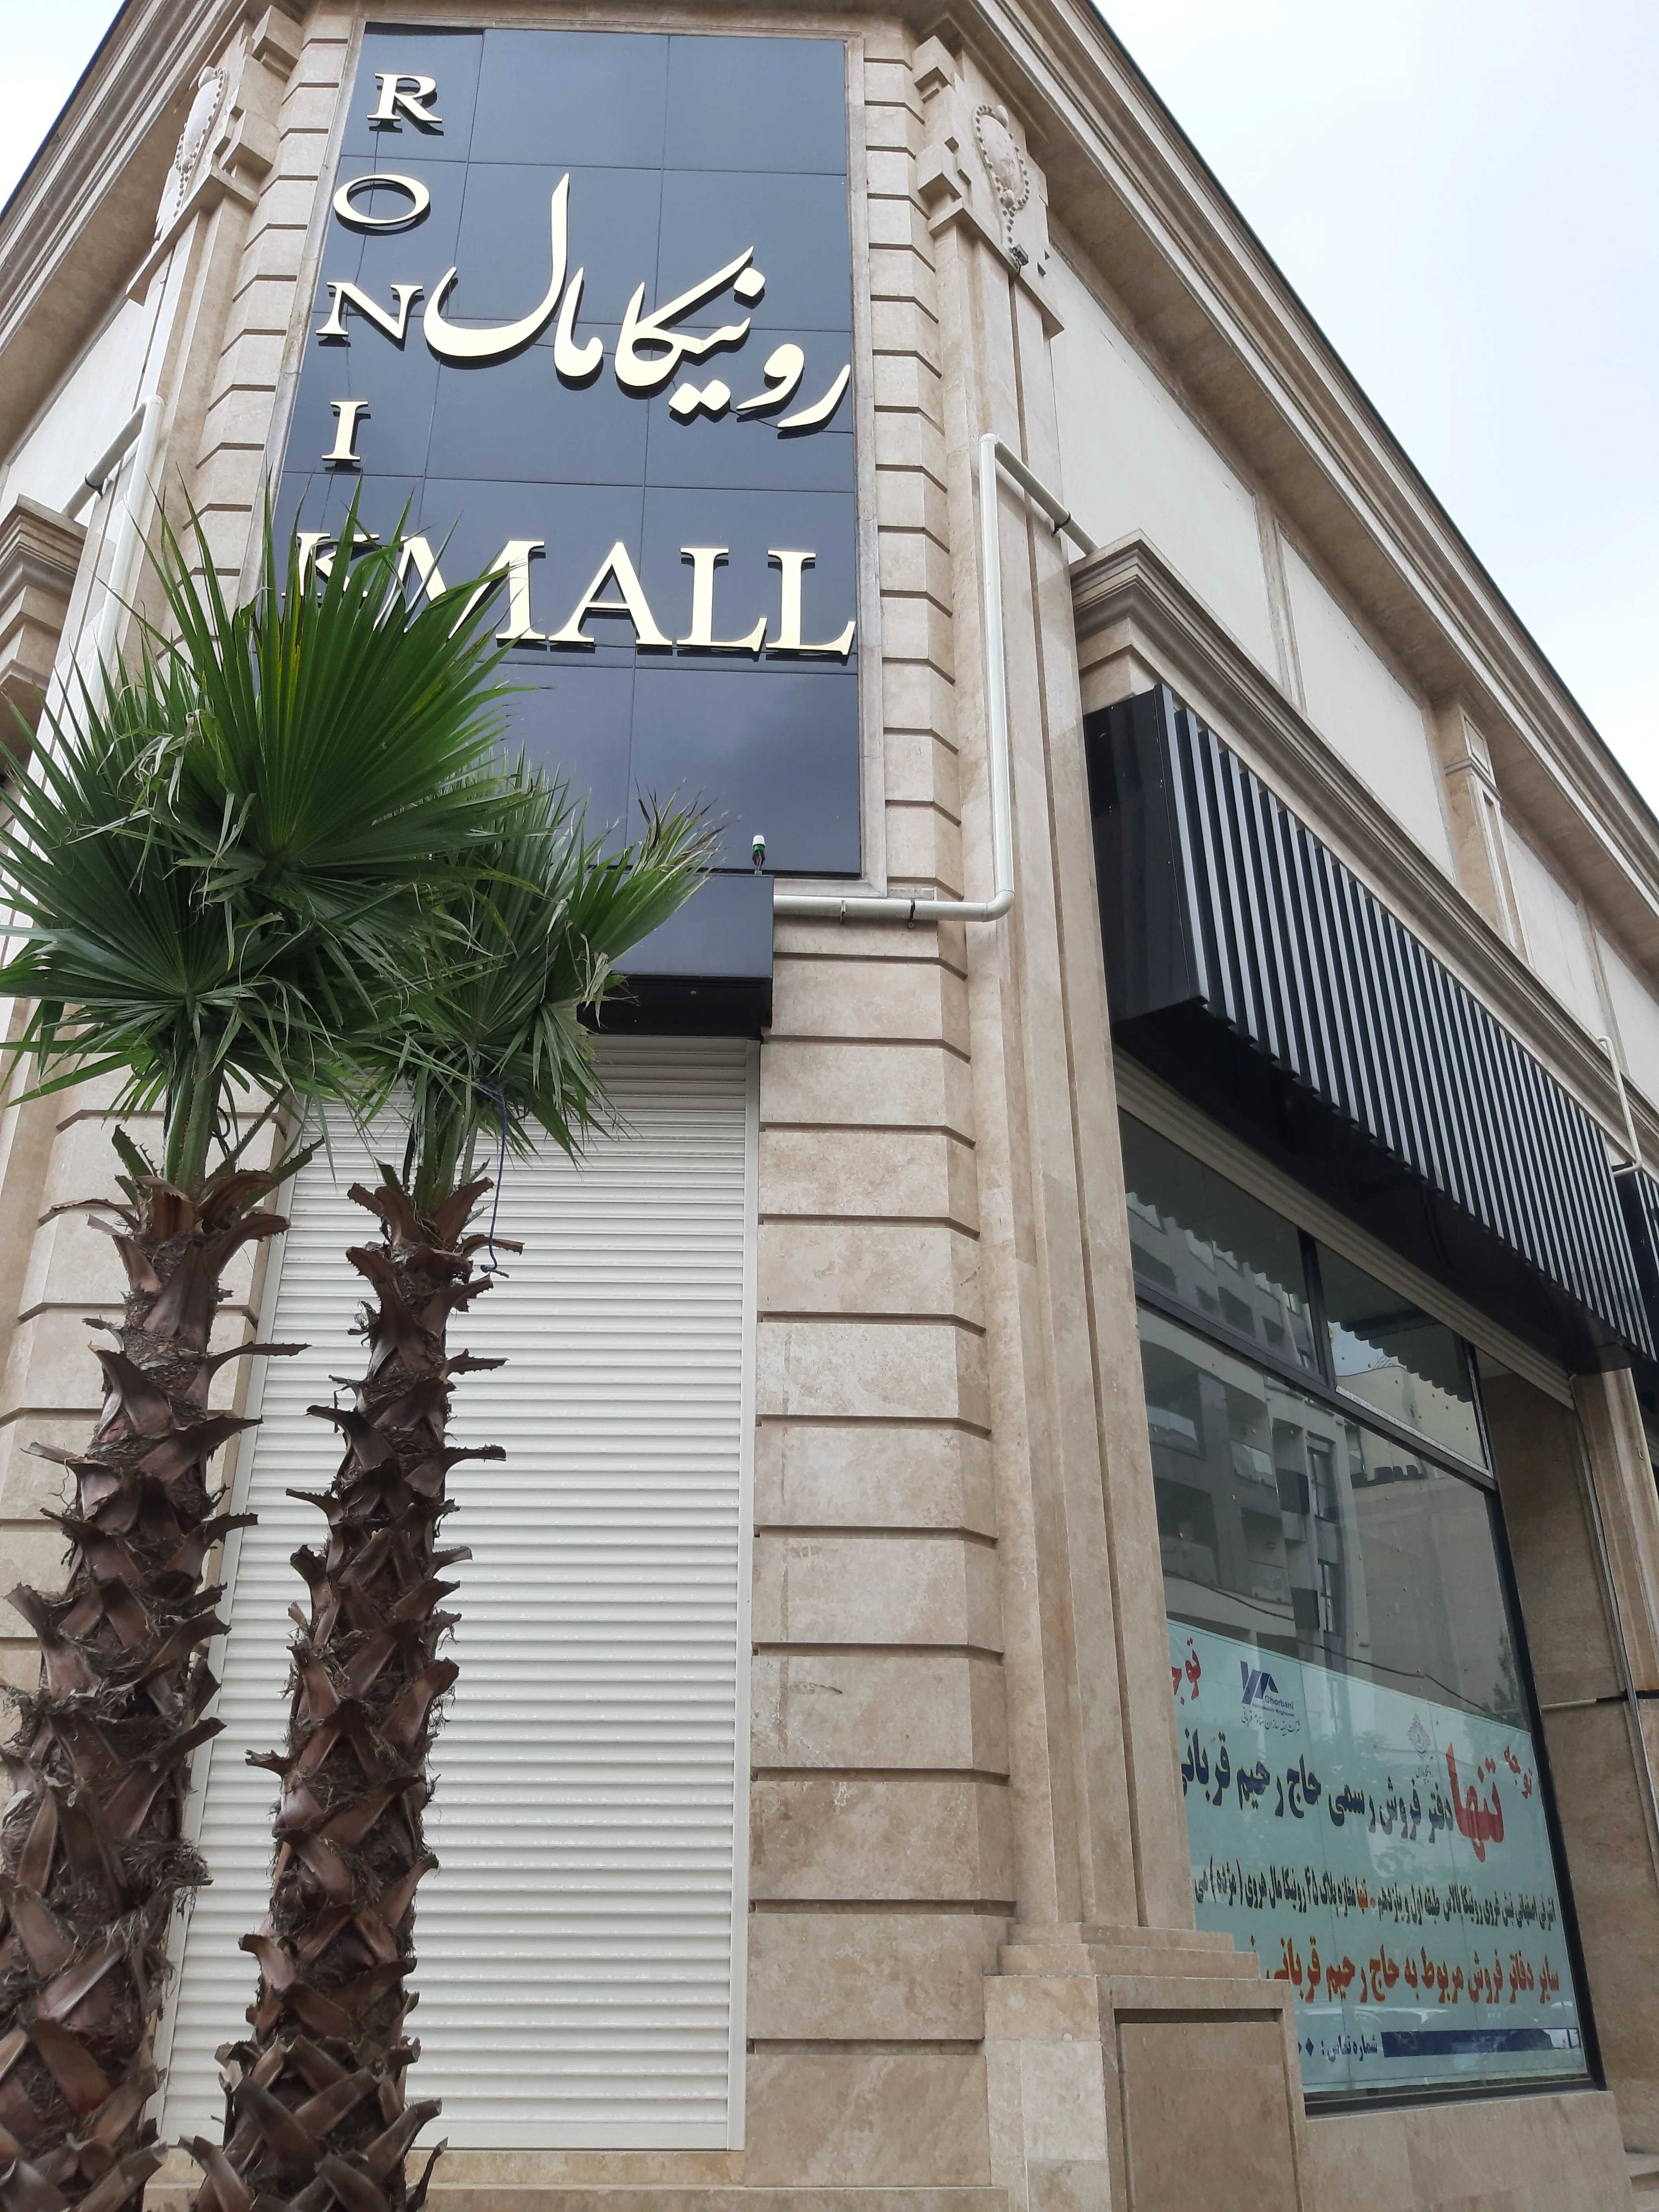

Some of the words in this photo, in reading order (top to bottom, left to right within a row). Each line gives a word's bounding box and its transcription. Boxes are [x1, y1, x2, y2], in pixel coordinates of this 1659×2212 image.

[423, 173, 603, 378] مال
[615, 246, 851, 428] رونیکا
[372, 535, 856, 656] MALL
[1264, 1695, 1294, 1710] Ghorbani
[1236, 1761, 1284, 1817] رحیم
[1287, 1754, 1322, 1818] حاج
[1329, 1784, 1376, 1833] رسمی
[1380, 1775, 1421, 1841] فروش
[1428, 1782, 1454, 1843] دفتر
[1446, 1743, 1504, 1862] تنها
[1269, 1864, 1282, 1909] مال
[1282, 1866, 1307, 1913] رونیکا
[1326, 1956, 1368, 2003] رحیم
[1370, 1944, 1399, 2003] حاج
[1404, 1956, 1419, 2001] به
[1421, 1946, 1464, 2004] مربوط
[1468, 1948, 1503, 2004] فروش
[1509, 1950, 1534, 2004] دفاتر
[1539, 1955, 1559, 2004] سایر
